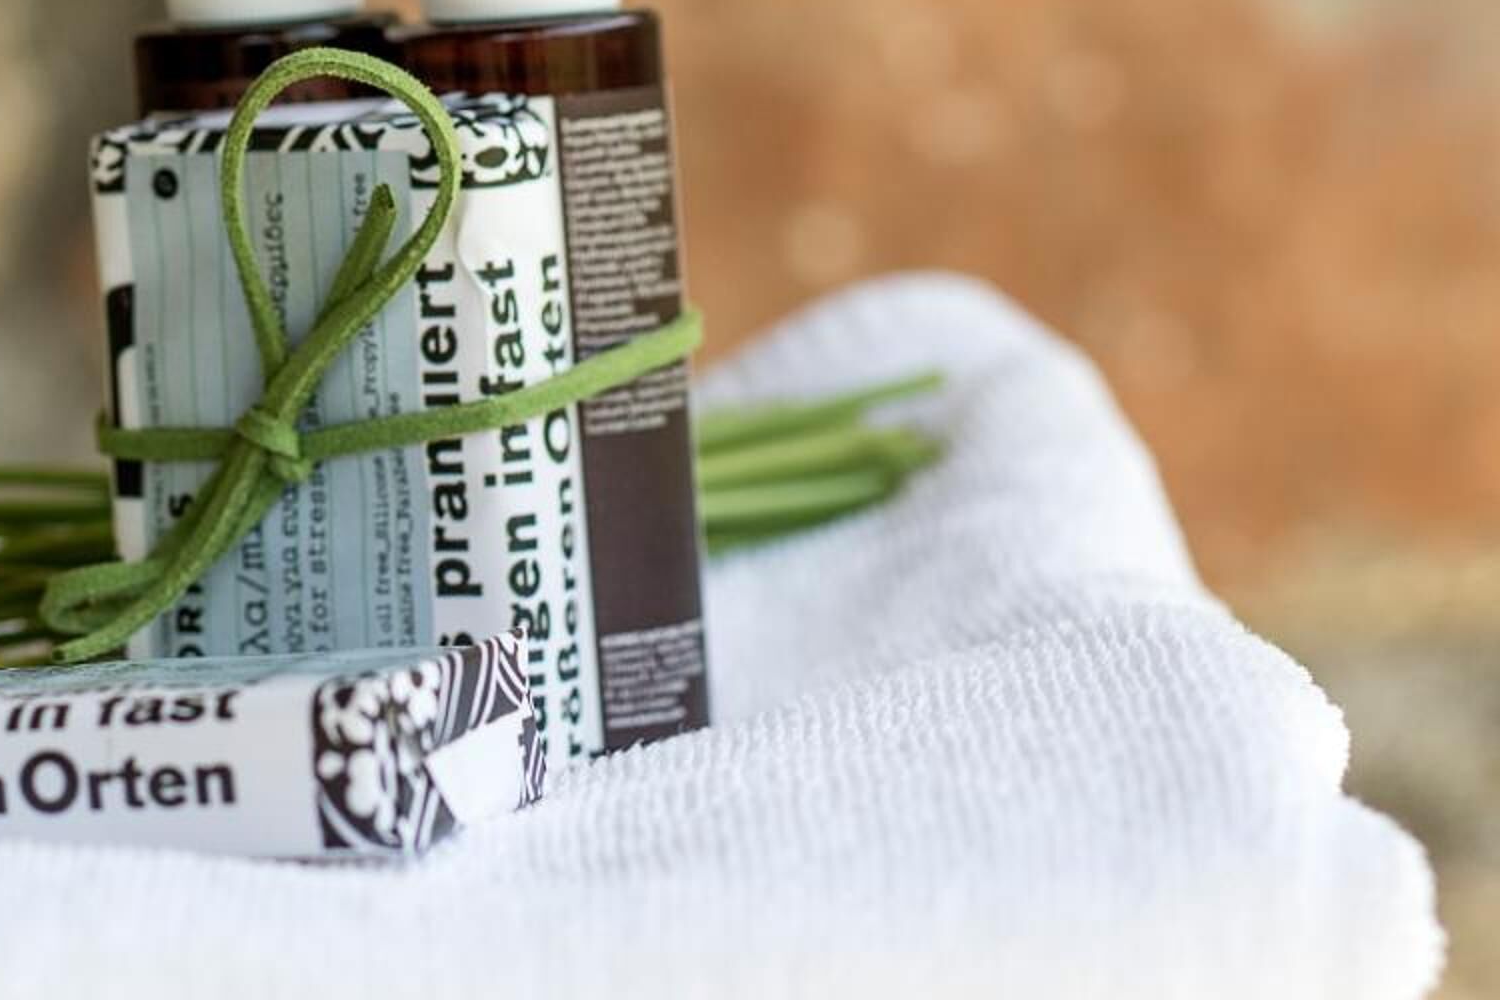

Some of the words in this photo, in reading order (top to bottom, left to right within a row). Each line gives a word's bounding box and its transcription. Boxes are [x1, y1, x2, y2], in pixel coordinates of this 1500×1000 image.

[475, 258, 525, 396] fast
[540, 254, 571, 465] Oten
[484, 423, 533, 487] in
[308, 586, 330, 635] for
[19, 750, 238, 813] Orten
